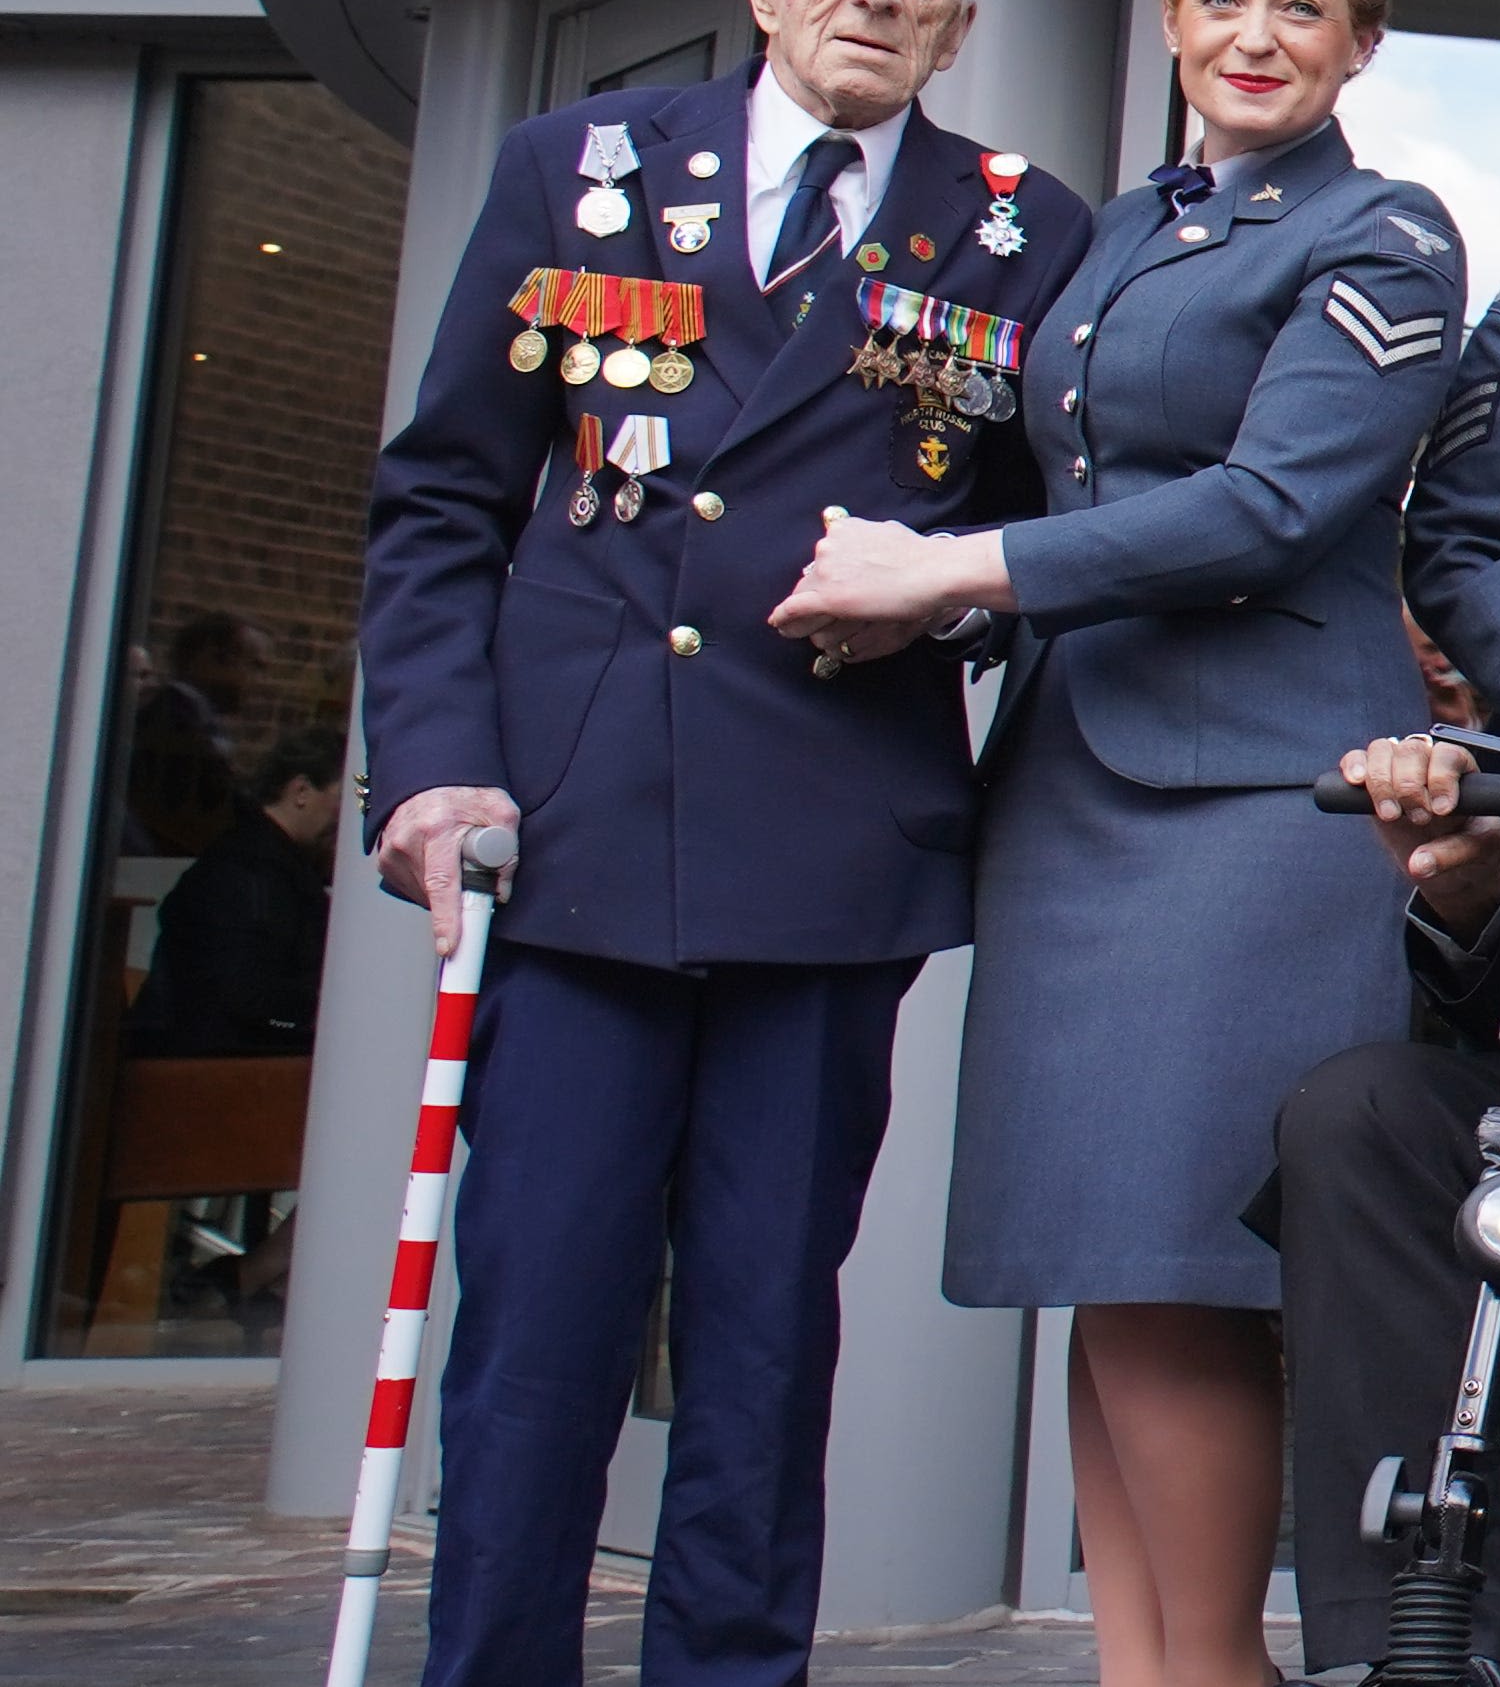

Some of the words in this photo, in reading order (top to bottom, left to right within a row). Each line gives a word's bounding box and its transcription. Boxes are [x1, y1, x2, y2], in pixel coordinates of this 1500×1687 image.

[900, 406, 934, 427] NORTH
[935, 409, 972, 433] RUSSIA
[919, 419, 946, 432] CLUB
